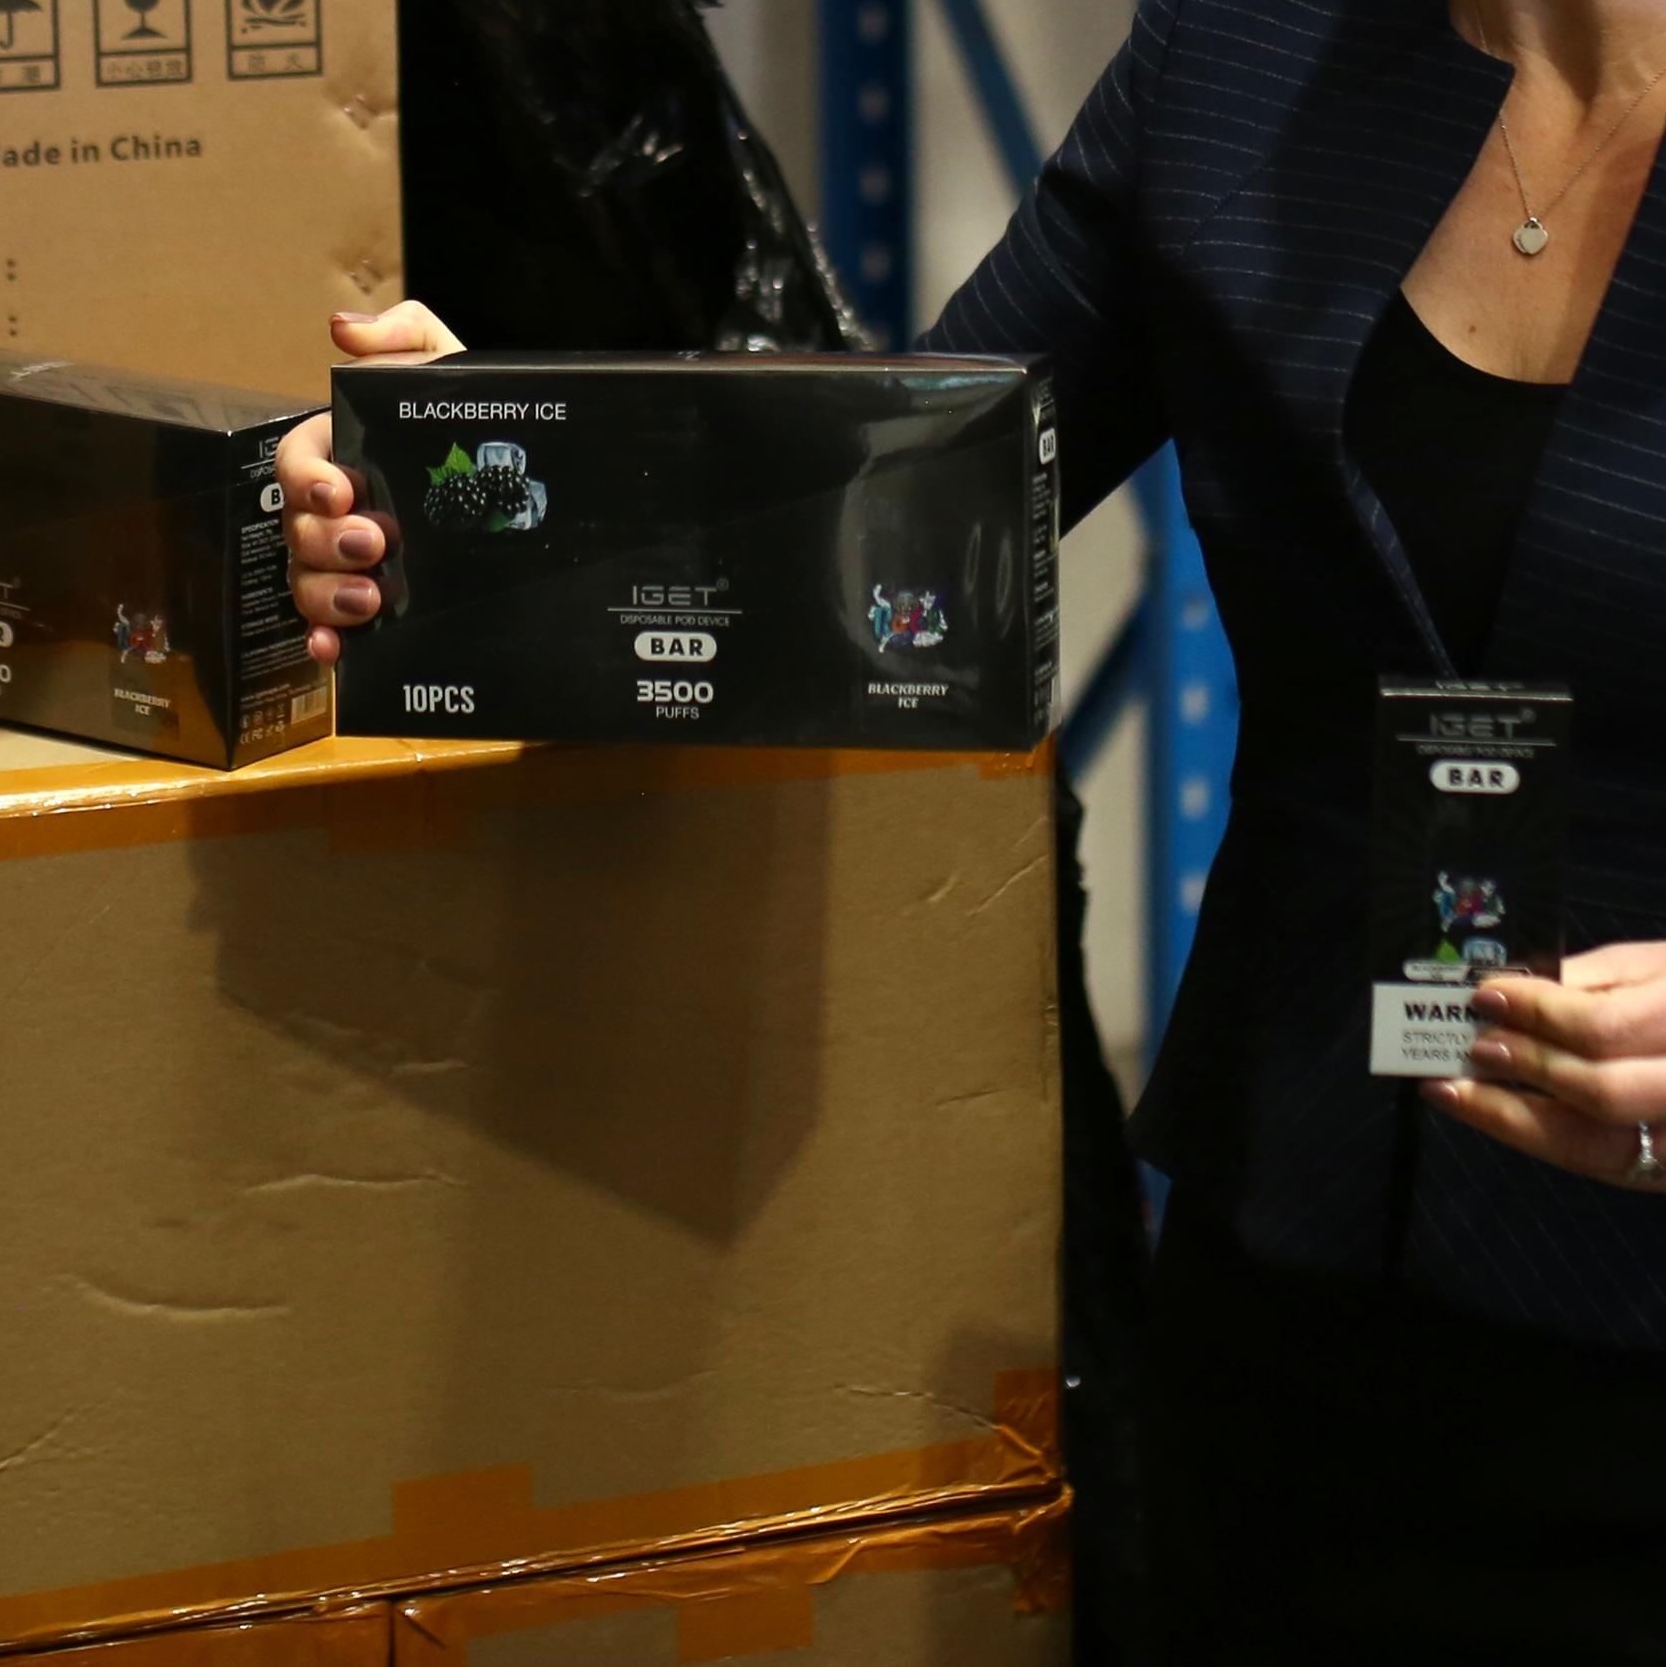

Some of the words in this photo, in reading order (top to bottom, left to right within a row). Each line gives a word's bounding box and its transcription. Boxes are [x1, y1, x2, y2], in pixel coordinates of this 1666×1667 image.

[72, 139, 101, 164] in
[110, 135, 203, 163] China
[398, 400, 530, 421] BLACKBERRY
[535, 401, 568, 421] ICE
[259, 435, 280, 459] IG
[633, 585, 718, 606] IGET
[620, 614, 672, 626] DISPOSABLE
[675, 616, 696, 626] POD
[698, 617, 730, 627] DEVICE
[651, 637, 704, 656] BAR
[114, 687, 171, 709] BLACKBERRY
[403, 683, 475, 715] 10PCS
[636, 681, 715, 704] 3500
[868, 682, 949, 696] BLACKBERRY
[135, 704, 151, 716] ICE
[898, 697, 920, 708] ICE
[656, 706, 700, 720] PUFFS
[1430, 714, 1521, 739] IGET
[1448, 768, 1504, 789] BAR
[1404, 1002, 1480, 1022] WARN
[1403, 1031, 1470, 1046] STRICTLY
[1401, 1048, 1450, 1061] YEARS
